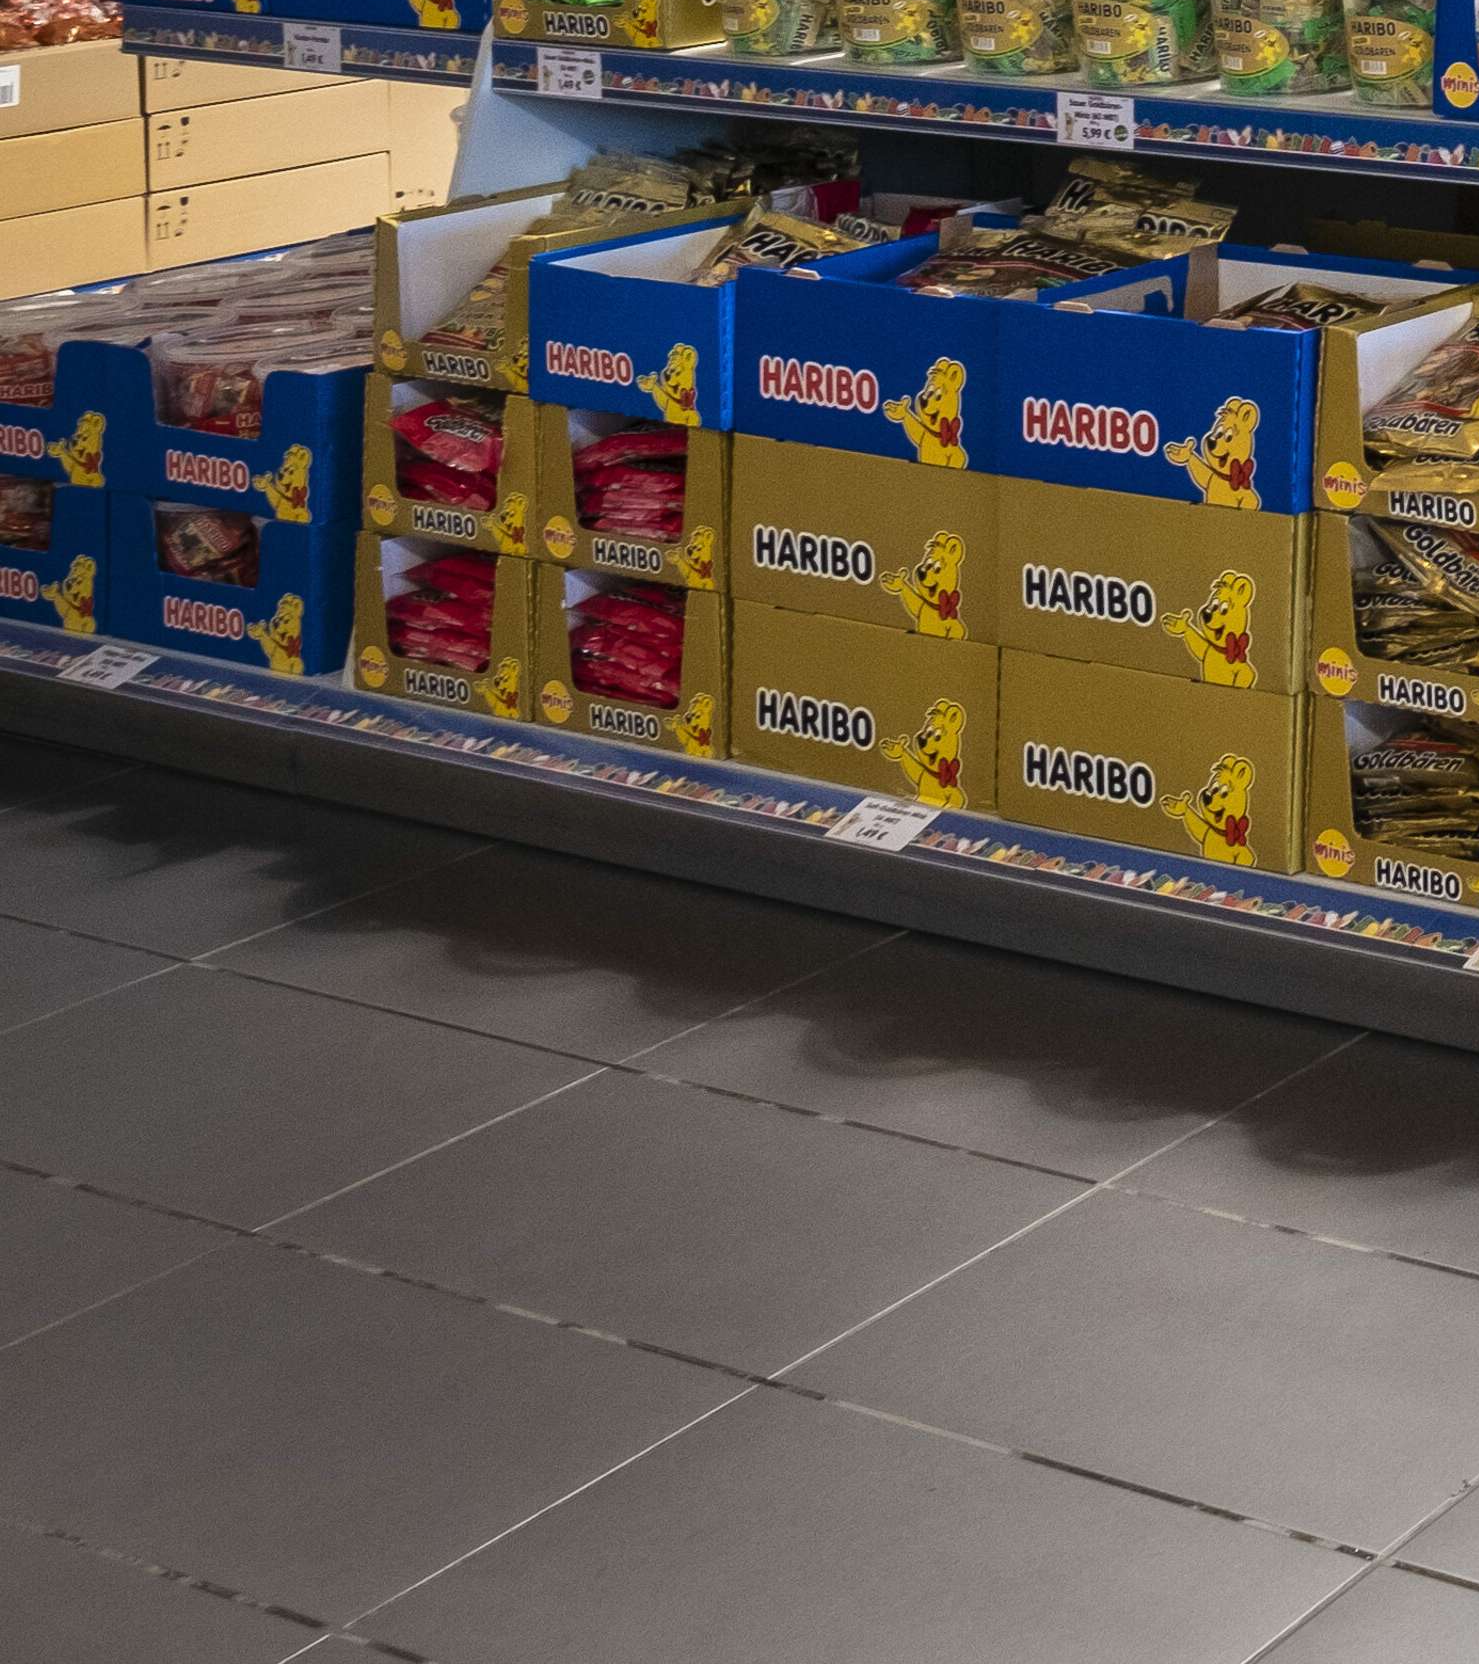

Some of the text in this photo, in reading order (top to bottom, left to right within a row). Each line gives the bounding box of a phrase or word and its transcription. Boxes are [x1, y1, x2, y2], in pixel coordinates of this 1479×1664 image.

[546, 13, 609, 38] HARIBO
[423, 350, 490, 381] HARIBO
[546, 341, 635, 385] HARIBO
[759, 355, 878, 414] HARIBO
[1023, 398, 1159, 457] HARIBO
[165, 451, 249, 492] HARIBO
[413, 506, 476, 539] HARIBO
[1388, 490, 1477, 528] HARIBO
[754, 524, 875, 584] HARIBO
[1023, 563, 1156, 626] HARIBO
[403, 668, 470, 704] HARIBO
[1317, 660, 1358, 683] minis
[589, 704, 660, 740] HARIBO
[1023, 742, 1155, 807] HARIBO
[1353, 751, 1464, 774] Goldbären
[1375, 856, 1462, 902] HARIBO
